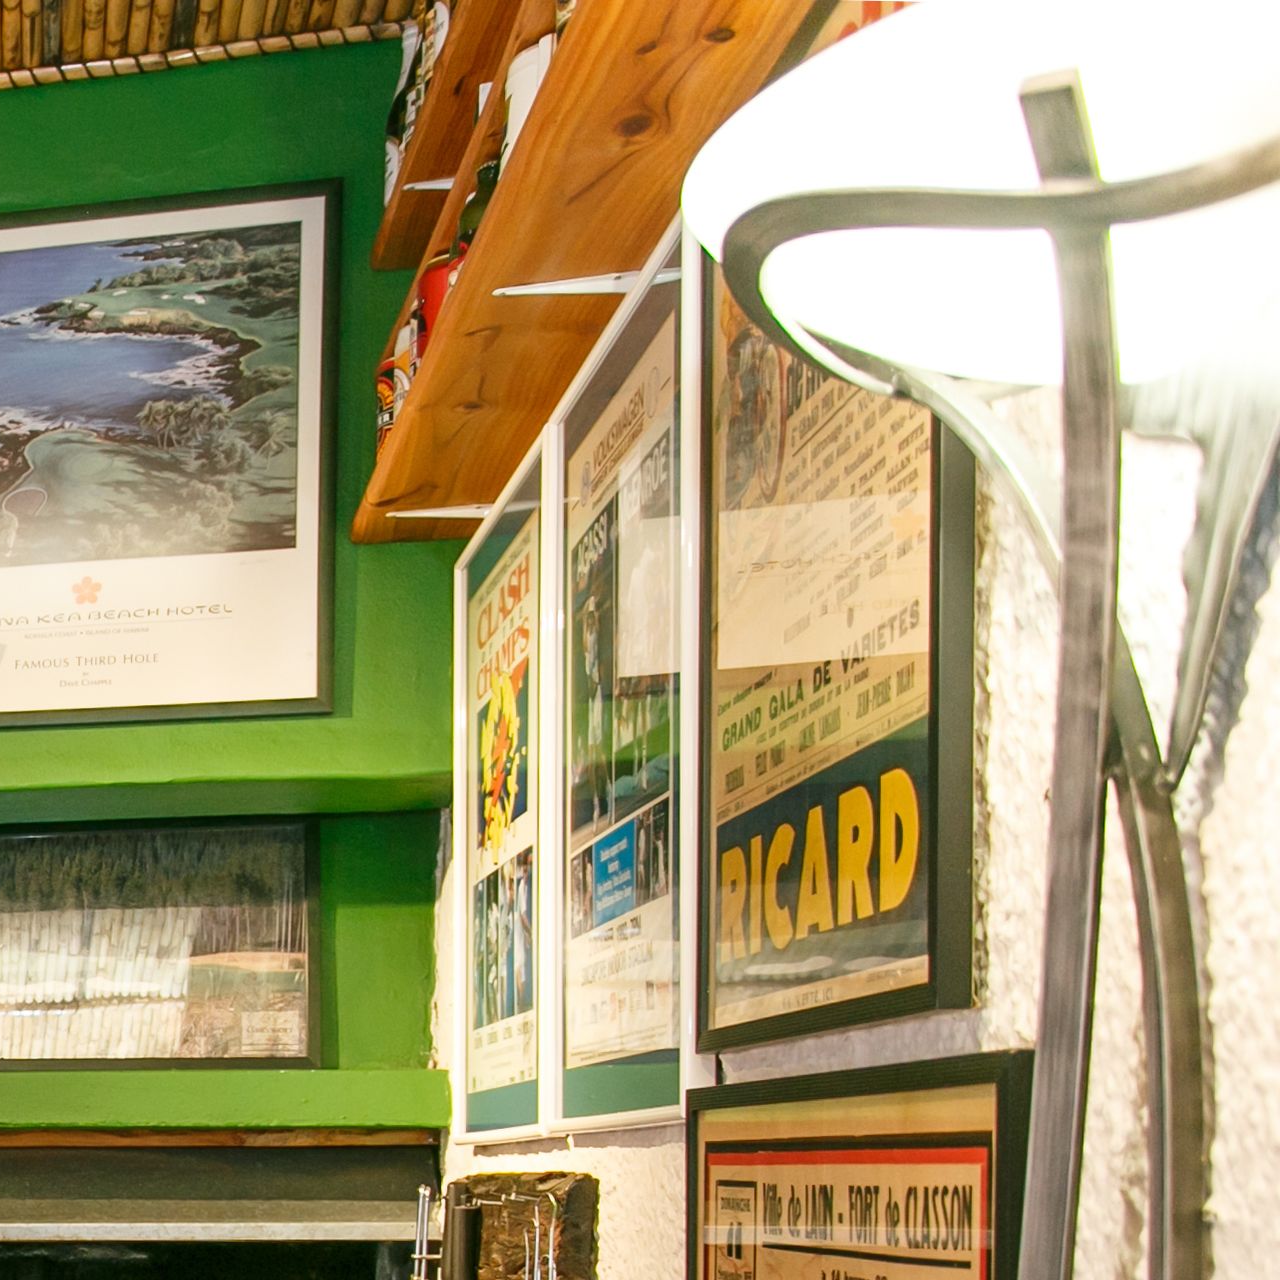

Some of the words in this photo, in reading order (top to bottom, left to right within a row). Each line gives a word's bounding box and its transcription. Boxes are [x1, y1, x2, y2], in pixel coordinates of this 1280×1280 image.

[37, 611, 82, 625] KEA
[87, 607, 160, 621] BEACH
[165, 603, 234, 618] HOTEL
[477, 551, 531, 650] CLASH
[14, 656, 71, 671] FAMOUS
[76, 654, 118, 668] THIRD
[122, 652, 160, 665] HOLE
[476, 614, 531, 701] CHAMPS
[722, 706, 762, 752] GRAND
[768, 678, 805, 722] GALA
[812, 659, 832, 695] DE
[719, 767, 921, 965] RICARD
[848, 1185, 880, 1244] FORT
